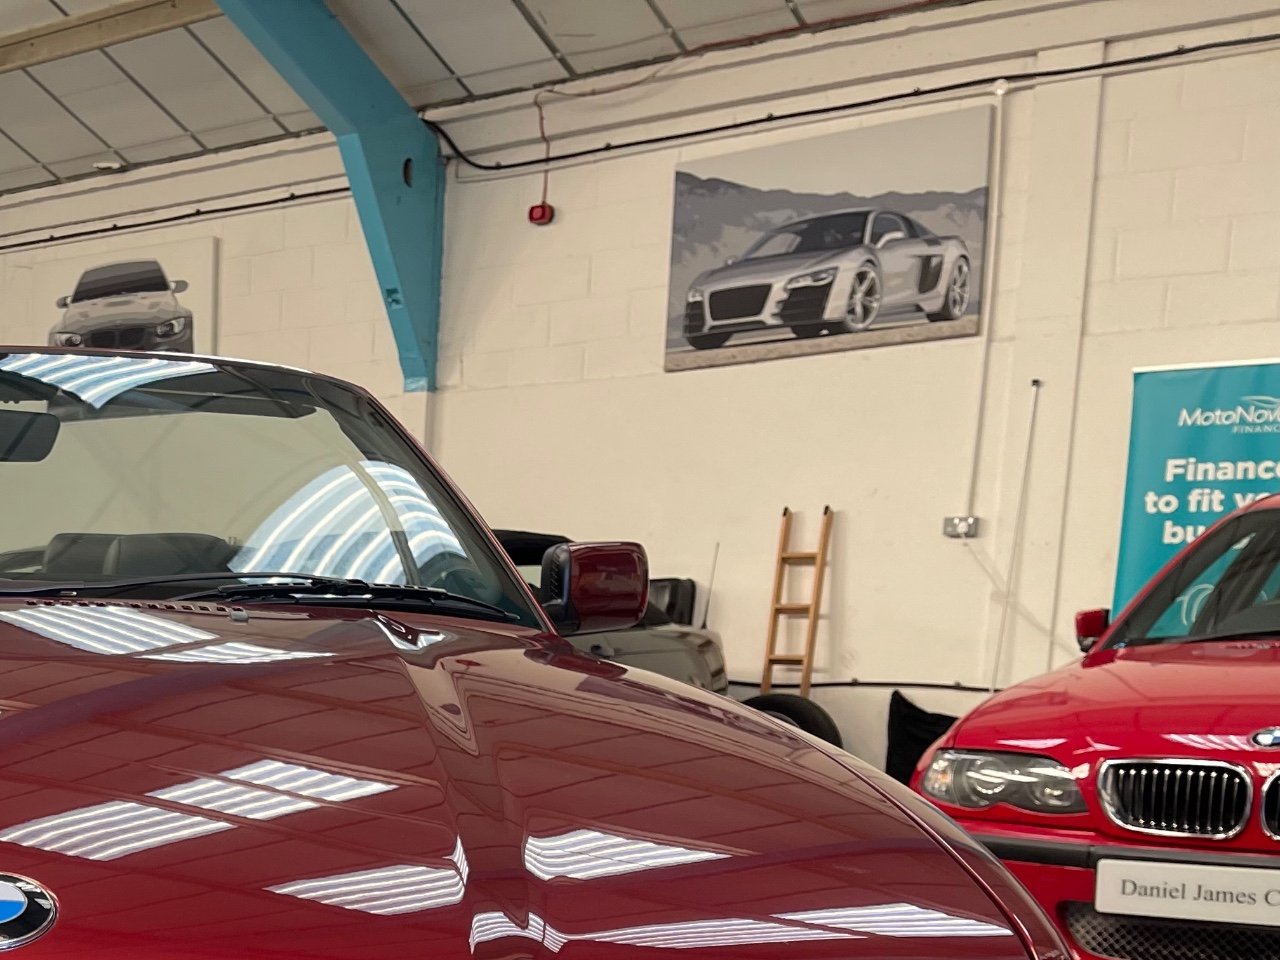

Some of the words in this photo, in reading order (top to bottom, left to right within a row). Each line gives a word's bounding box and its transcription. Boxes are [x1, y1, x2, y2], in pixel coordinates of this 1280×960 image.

[1233, 424, 1280, 433] FINANC
[1144, 491, 1179, 514] to
[1188, 488, 1225, 512] fit
[1121, 878, 1186, 900] Daniel
[1193, 884, 1257, 905] James
